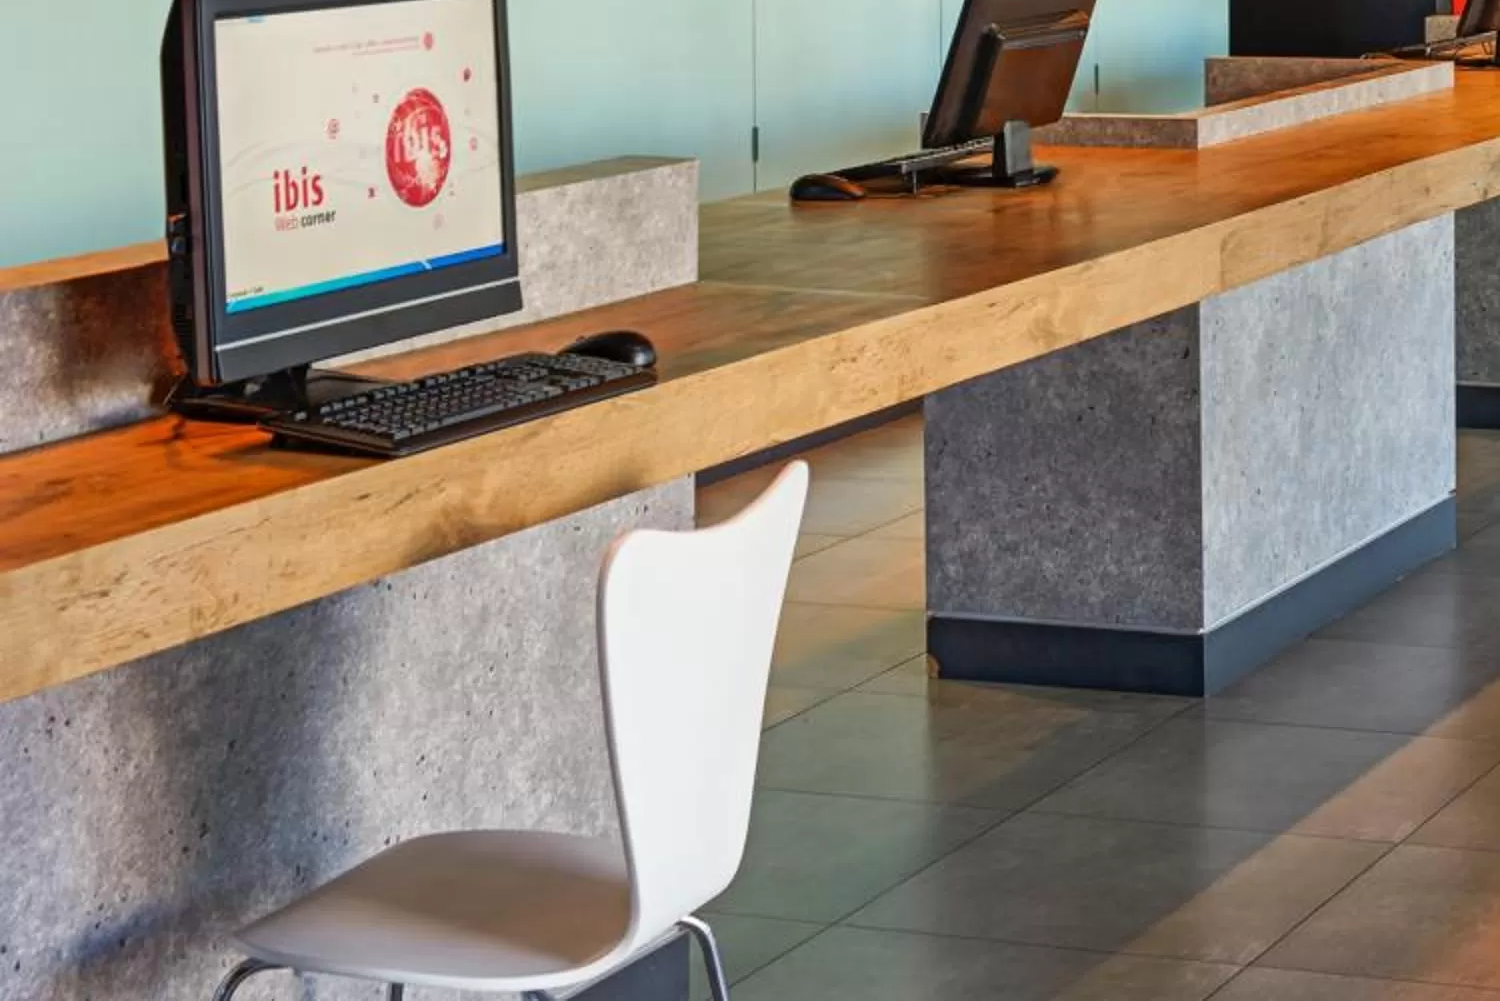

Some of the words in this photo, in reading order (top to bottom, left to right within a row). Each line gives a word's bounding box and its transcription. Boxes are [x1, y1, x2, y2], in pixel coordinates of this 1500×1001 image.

[391, 109, 448, 163] ibis
[273, 166, 324, 213] ibis
[300, 210, 337, 228] corner
